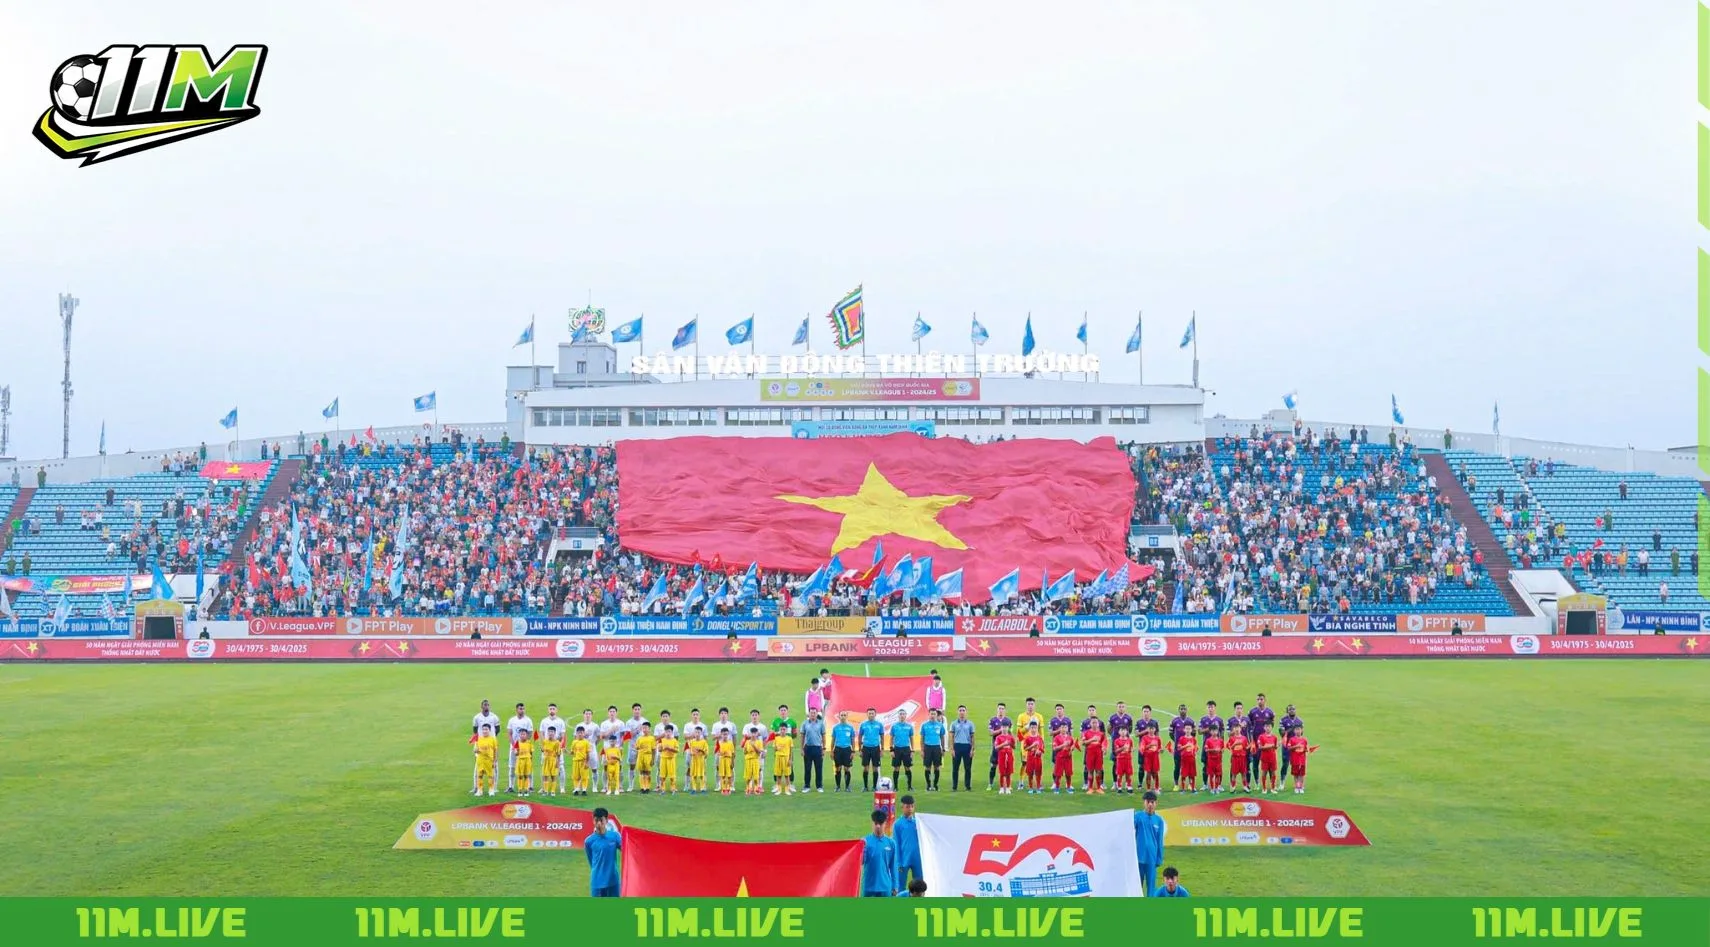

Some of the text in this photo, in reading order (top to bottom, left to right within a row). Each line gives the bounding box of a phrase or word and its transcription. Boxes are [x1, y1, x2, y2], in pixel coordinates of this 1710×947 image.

[631, 351, 694, 374] SÂN
[706, 352, 768, 376] VẬN
[779, 350, 865, 378] ĐỘNG
[875, 350, 965, 373] THIÊN
[530, 619, 543, 630] LÂN
[548, 621, 561, 630] NPK
[562, 620, 579, 630] NINH
[581, 619, 598, 630] BÌNH
[978, 618, 1037, 631] JOGARBOLA
[1248, 618, 1298, 630] FPT Play
[1426, 618, 1476, 630] FPT Play
[1626, 614, 1640, 624] LÂN
[1646, 616, 1660, 624] NPK
[1662, 616, 1679, 625] NINH
[1680, 615, 1698, 626] BÌNH
[365, 620, 414, 633] FPT Play
[453, 621, 502, 634] FPT Play
[226, 645, 264, 653] 30/4/1975
[270, 645, 308, 653] 30/4/2025
[595, 644, 634, 652] 30/4/1975
[640, 644, 678, 652] 30/4/2025
[806, 644, 858, 652] LPBANK
[1178, 642, 1216, 650] 30/4/1975
[1222, 642, 1261, 650] 30/4/2025
[1551, 640, 1588, 649] 30/4/1975
[1595, 640, 1634, 649] 30/4/2025
[490, 822, 533, 830] V.LEAGUE
[546, 822, 582, 830] 2024/25
[979, 881, 1003, 892] 30.4
